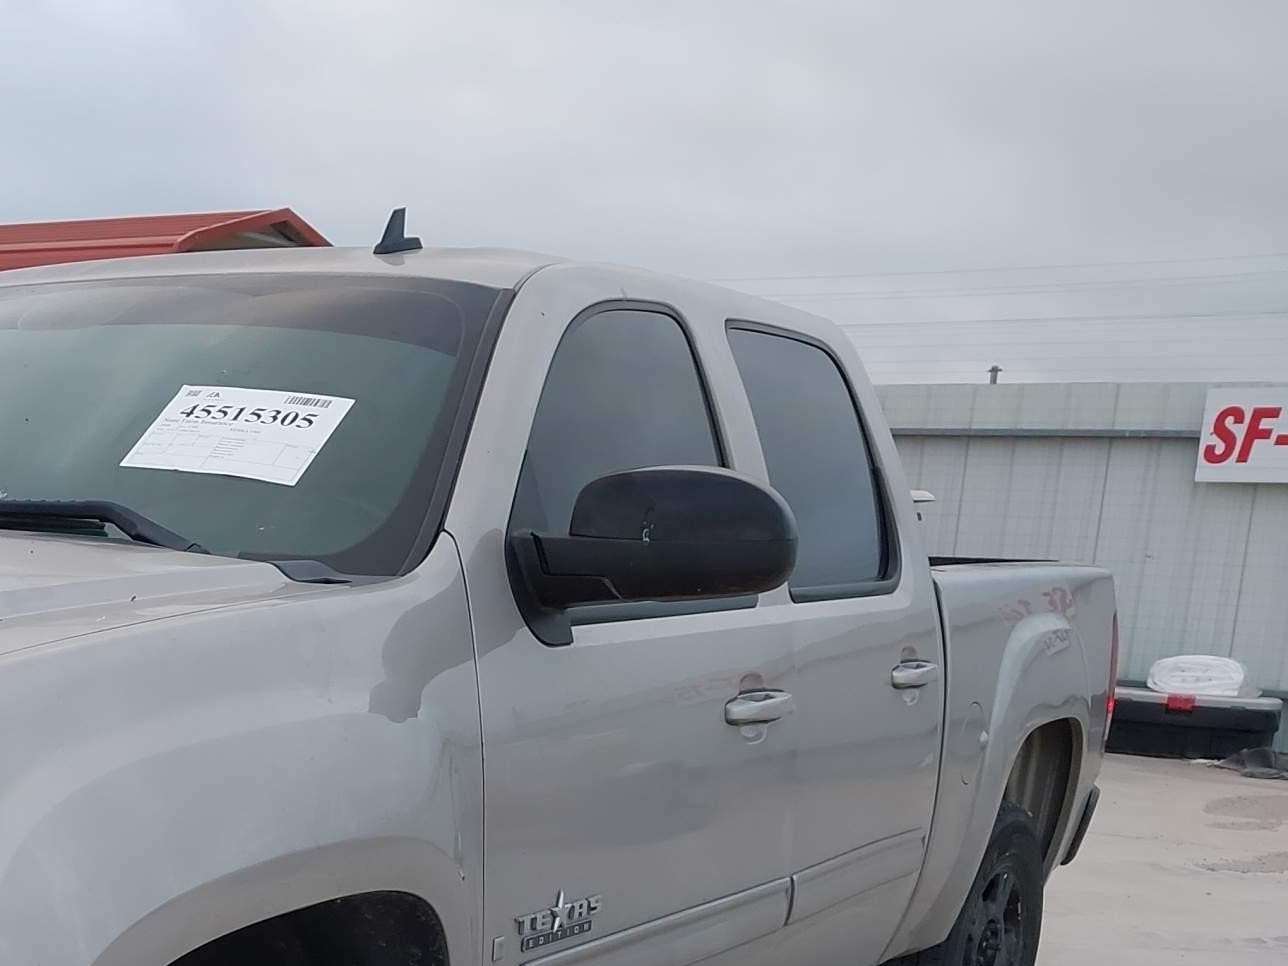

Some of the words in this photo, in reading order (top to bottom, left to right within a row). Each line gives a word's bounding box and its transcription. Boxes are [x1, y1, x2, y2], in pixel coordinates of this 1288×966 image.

[179, 403, 320, 429] 45515305
[514, 890, 603, 936] TEXAS
[527, 921, 591, 949] EDITION
